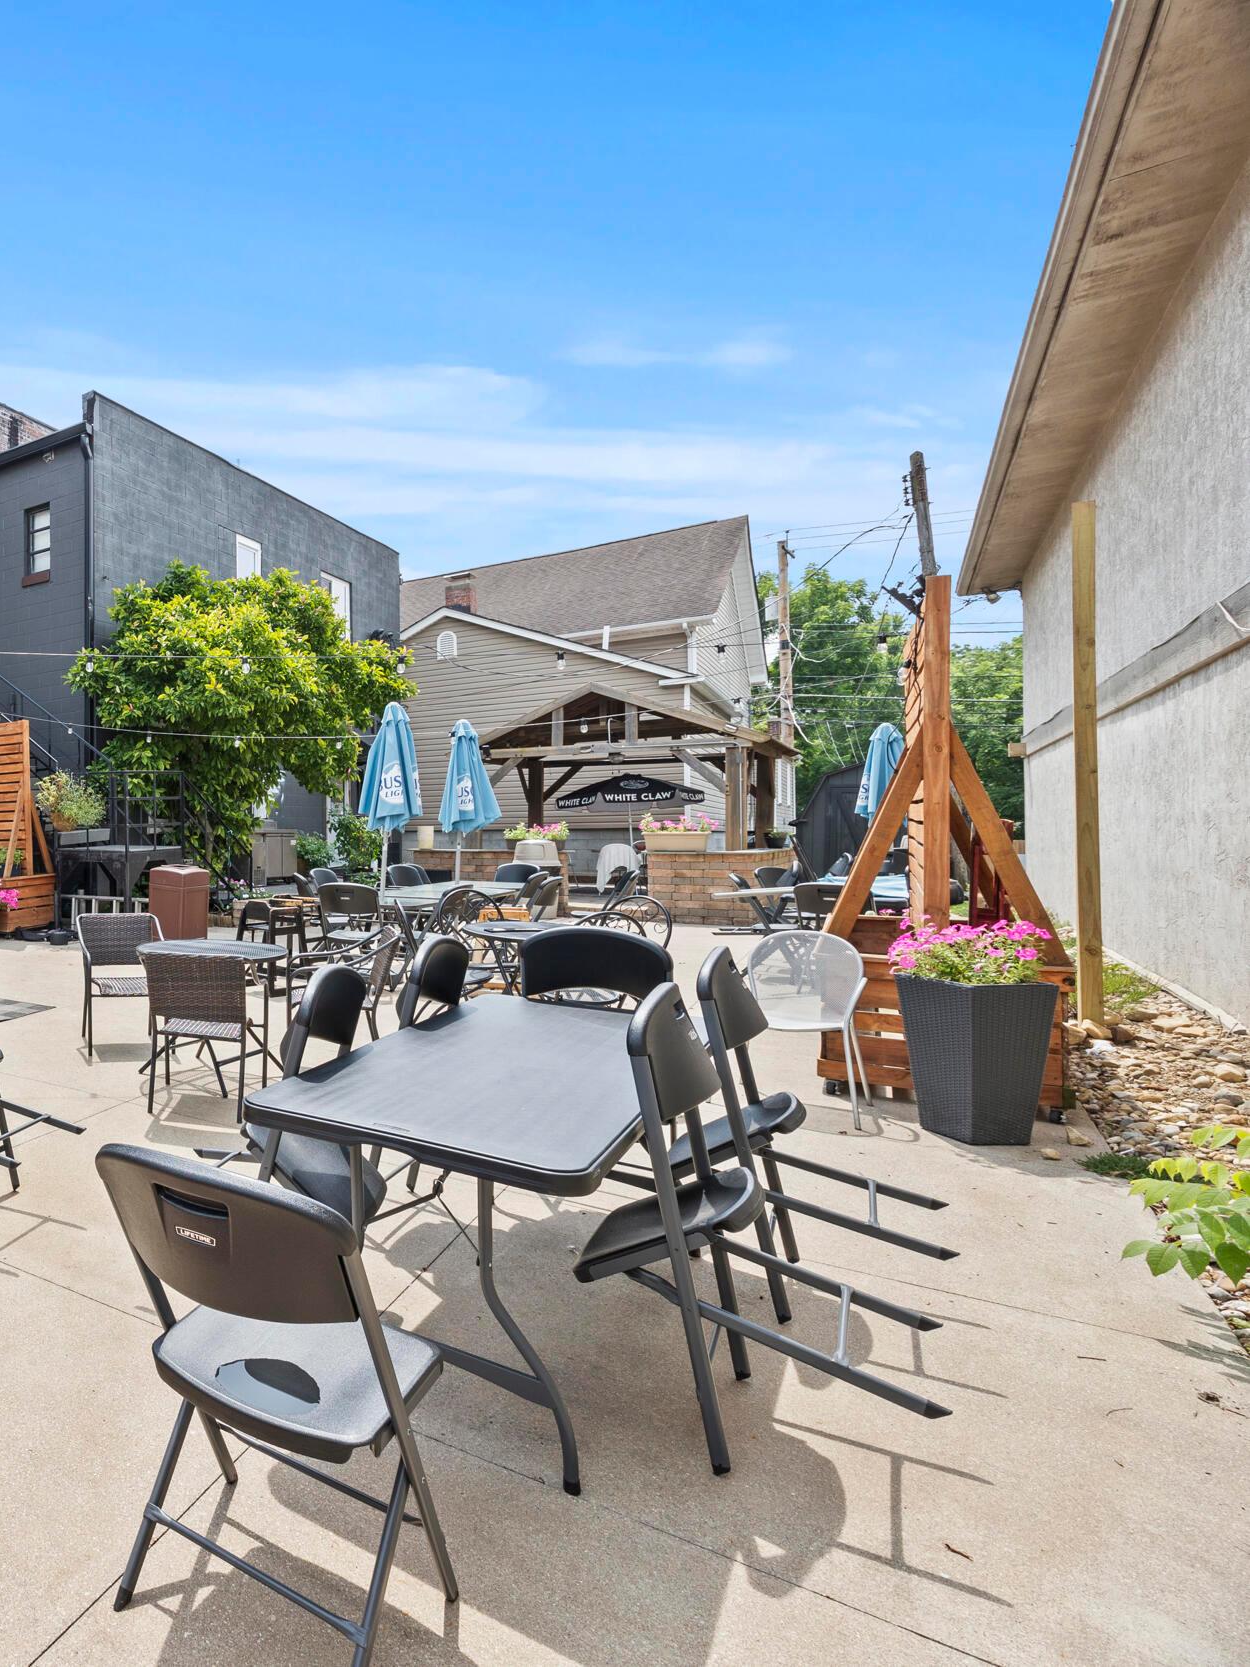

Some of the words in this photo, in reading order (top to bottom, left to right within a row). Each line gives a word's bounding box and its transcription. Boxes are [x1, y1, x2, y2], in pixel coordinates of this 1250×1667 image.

[604, 793, 638, 802] WHITE
[641, 791, 672, 801] CLAW
[558, 798, 581, 808] WHITE
[180, 1229, 211, 1243] LIFETIME
